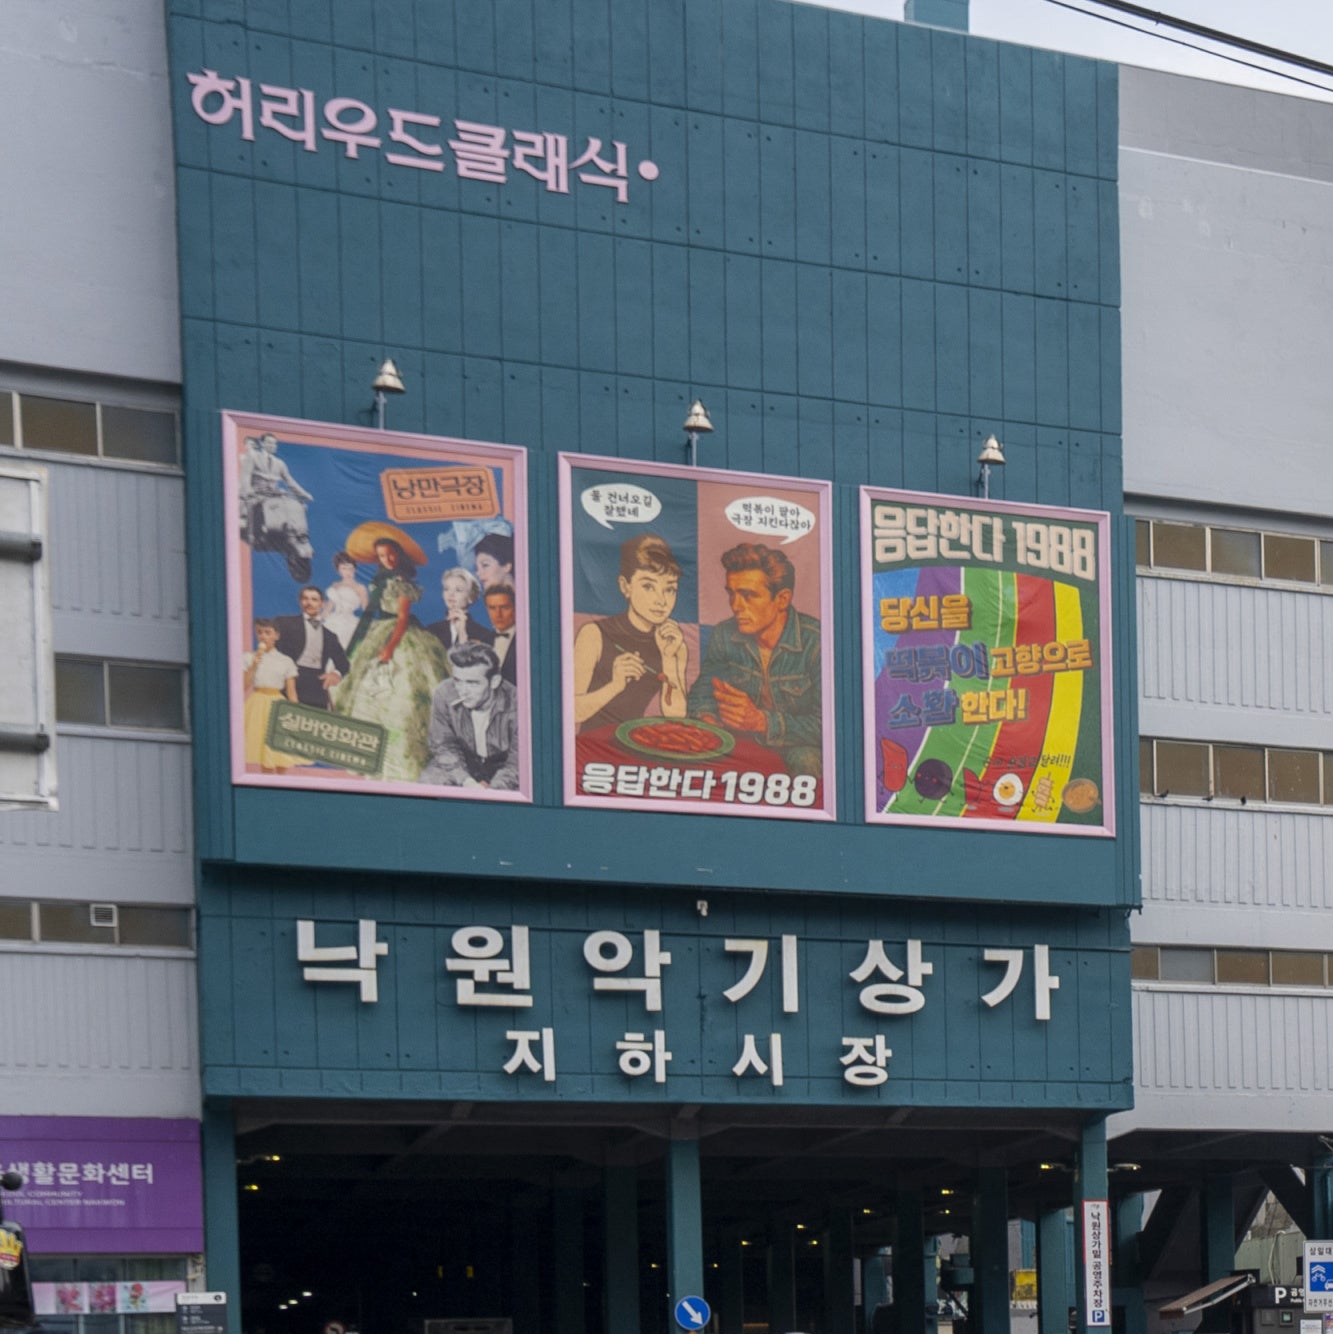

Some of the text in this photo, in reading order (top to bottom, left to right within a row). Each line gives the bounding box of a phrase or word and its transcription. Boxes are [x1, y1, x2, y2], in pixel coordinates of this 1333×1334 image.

[185, 67, 630, 204] 허리우드클래식
[391, 474, 486, 500] 낭만극장
[731, 512, 753, 527] 극장
[874, 504, 1097, 582] 응답한다 1988
[879, 594, 973, 634] 당신을
[990, 638, 1095, 679] 고향으로
[279, 712, 380, 753] 실버영화관
[582, 762, 817, 807] 응답한다 1988
[502, 1026, 894, 1087] 지하시장
[0, 1161, 154, 1186] 생활문화센터
[1092, 1260, 1103, 1309] 공영주차장
[1274, 1286, 1288, 1305] P
